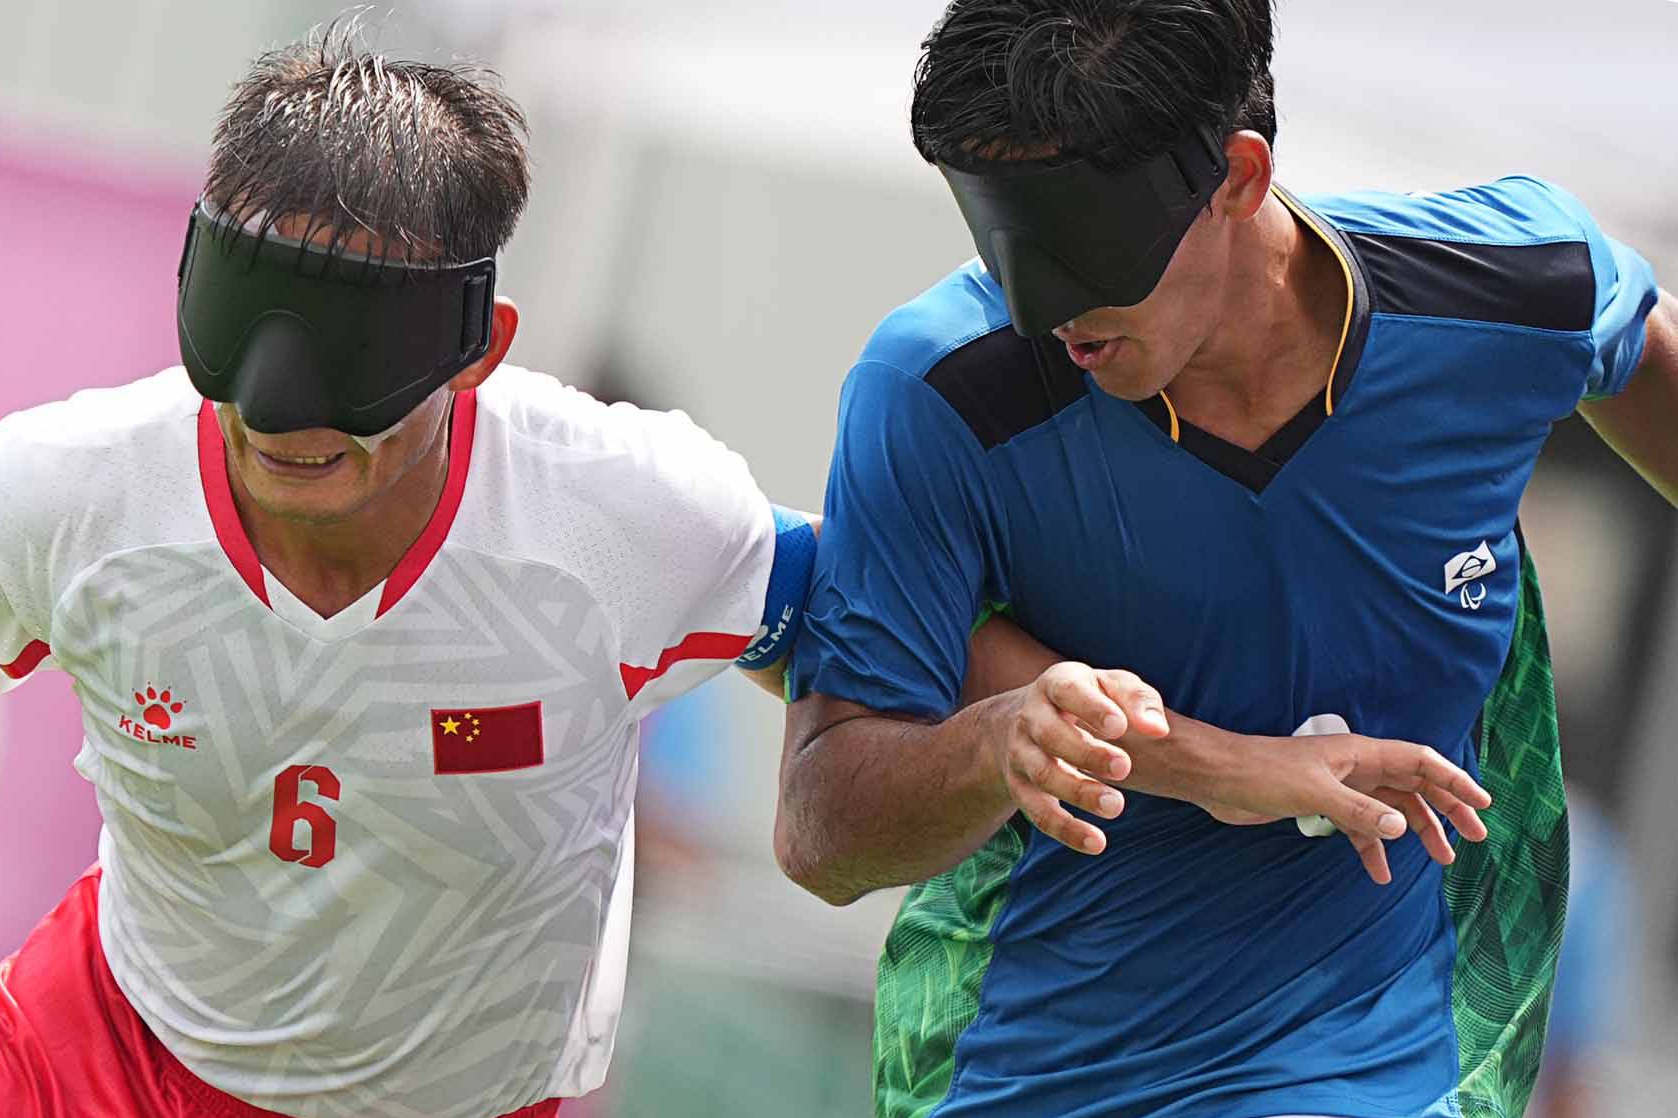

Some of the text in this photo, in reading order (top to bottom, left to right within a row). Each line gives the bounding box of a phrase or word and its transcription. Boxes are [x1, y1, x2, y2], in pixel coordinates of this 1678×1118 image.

[738, 604, 794, 663] ELME
[118, 714, 197, 750] KELME
[268, 763, 342, 869] 6
